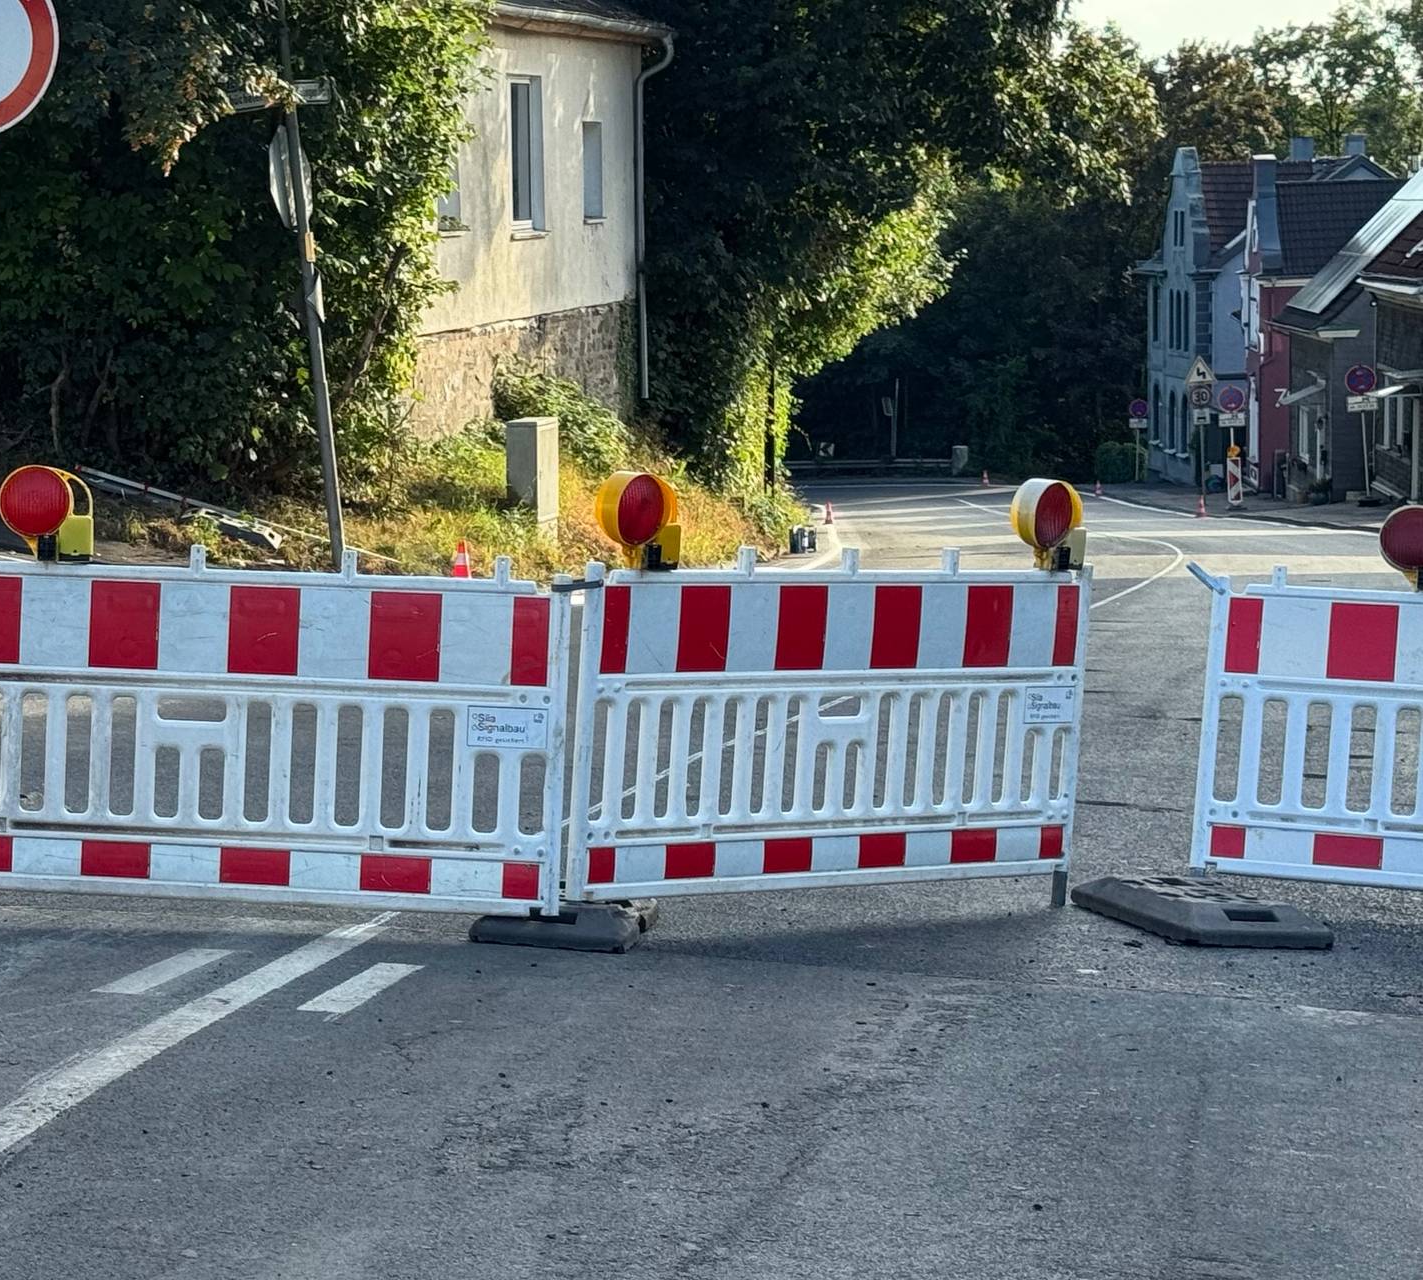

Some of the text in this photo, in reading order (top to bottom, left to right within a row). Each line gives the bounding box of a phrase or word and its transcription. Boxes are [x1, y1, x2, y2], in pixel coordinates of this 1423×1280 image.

[1193, 390, 1208, 402] 30
[478, 713, 496, 723] Sila
[478, 722, 526, 734] Signalbau
